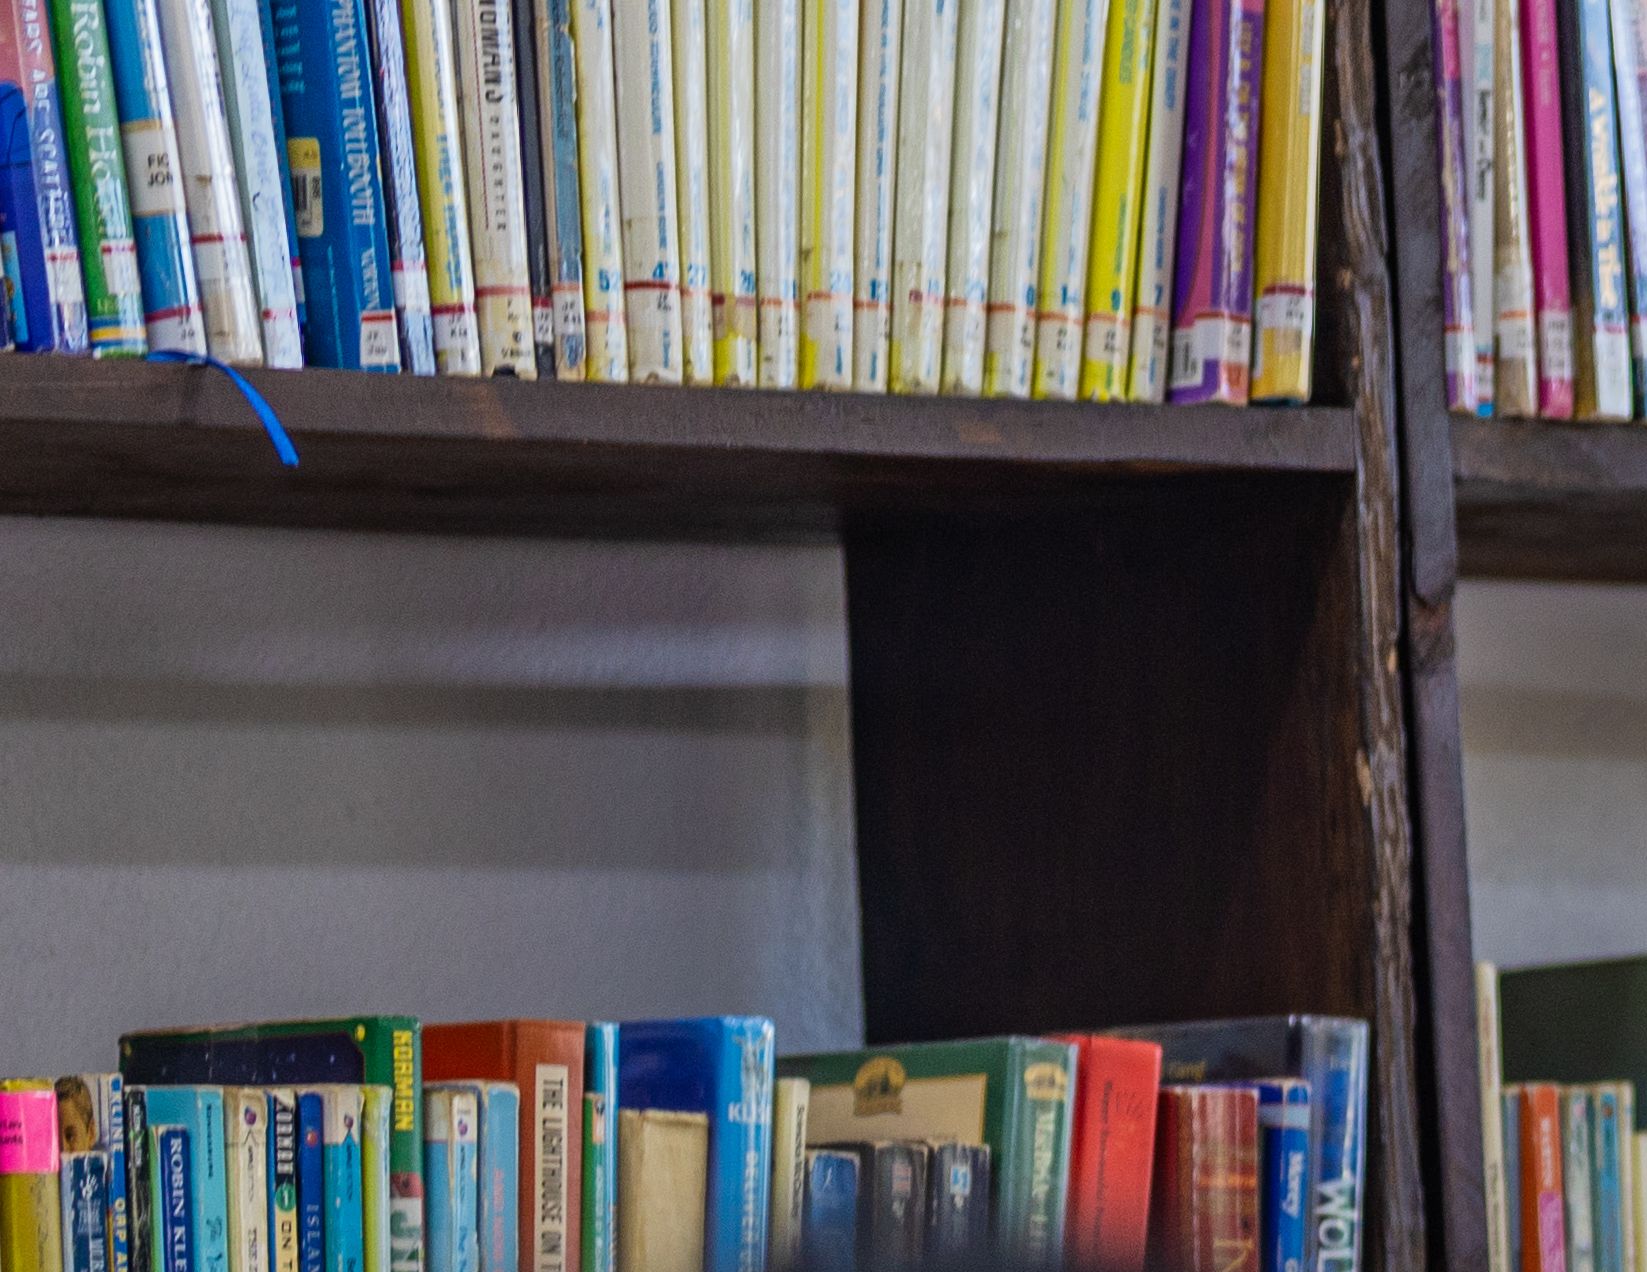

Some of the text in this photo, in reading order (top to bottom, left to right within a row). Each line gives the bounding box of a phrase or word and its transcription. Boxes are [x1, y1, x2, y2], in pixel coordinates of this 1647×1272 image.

[71, 1, 104, 114] Robin
[393, 1030, 414, 1131] KORMAN
[542, 1078, 564, 1110] THE
[170, 1136, 186, 1218] ROBIN
[541, 1118, 563, 1224] LIGHTHOUSE
[115, 1197, 127, 1242] ORP
[281, 1221, 292, 1250] ON
[541, 1231, 561, 1253] ON
